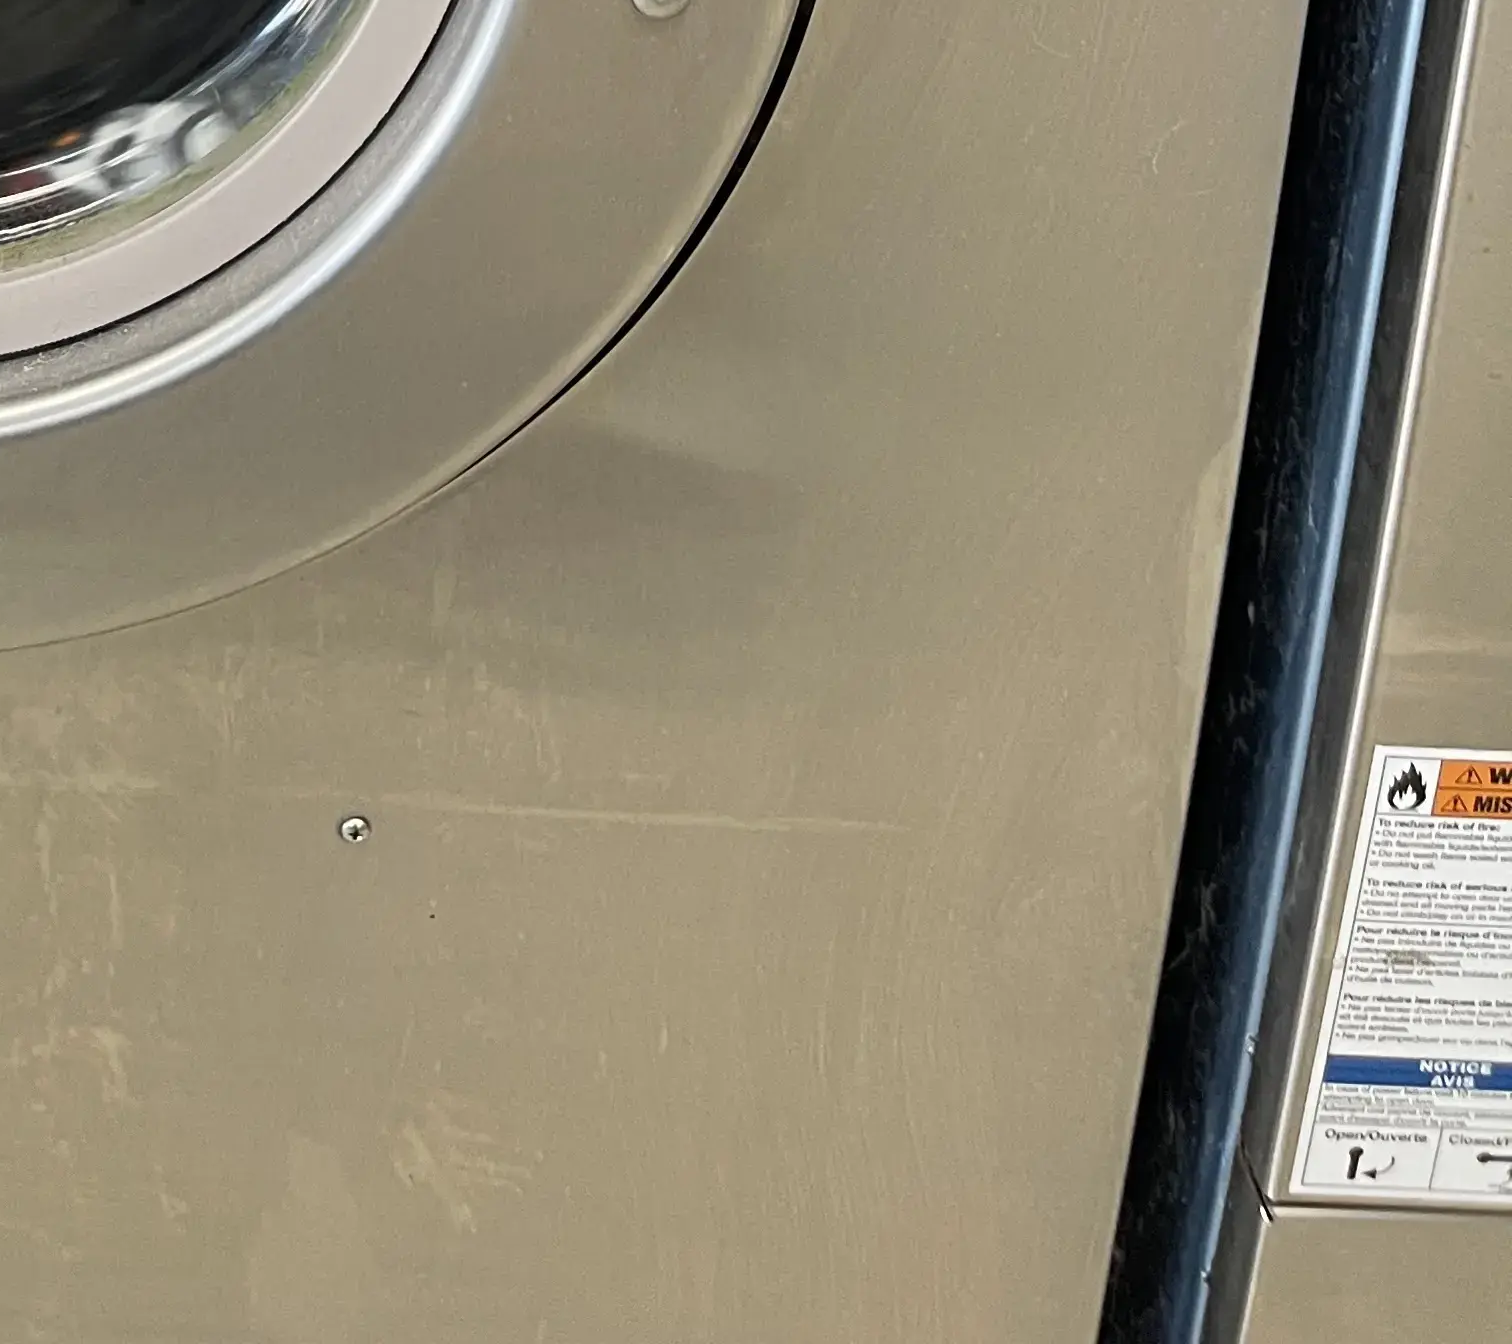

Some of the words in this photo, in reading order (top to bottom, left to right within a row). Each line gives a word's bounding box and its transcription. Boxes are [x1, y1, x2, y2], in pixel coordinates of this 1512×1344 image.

[1379, 818, 1389, 827] To
[1395, 819, 1435, 829] reduce
[1438, 821, 1459, 830] risk
[1462, 821, 1475, 830] of
[1367, 877, 1379, 887] To
[1383, 879, 1422, 889] reduce
[1426, 880, 1447, 890] risk
[1420, 1060, 1492, 1075] NOTICE
[1430, 1075, 1474, 1088] AVIS
